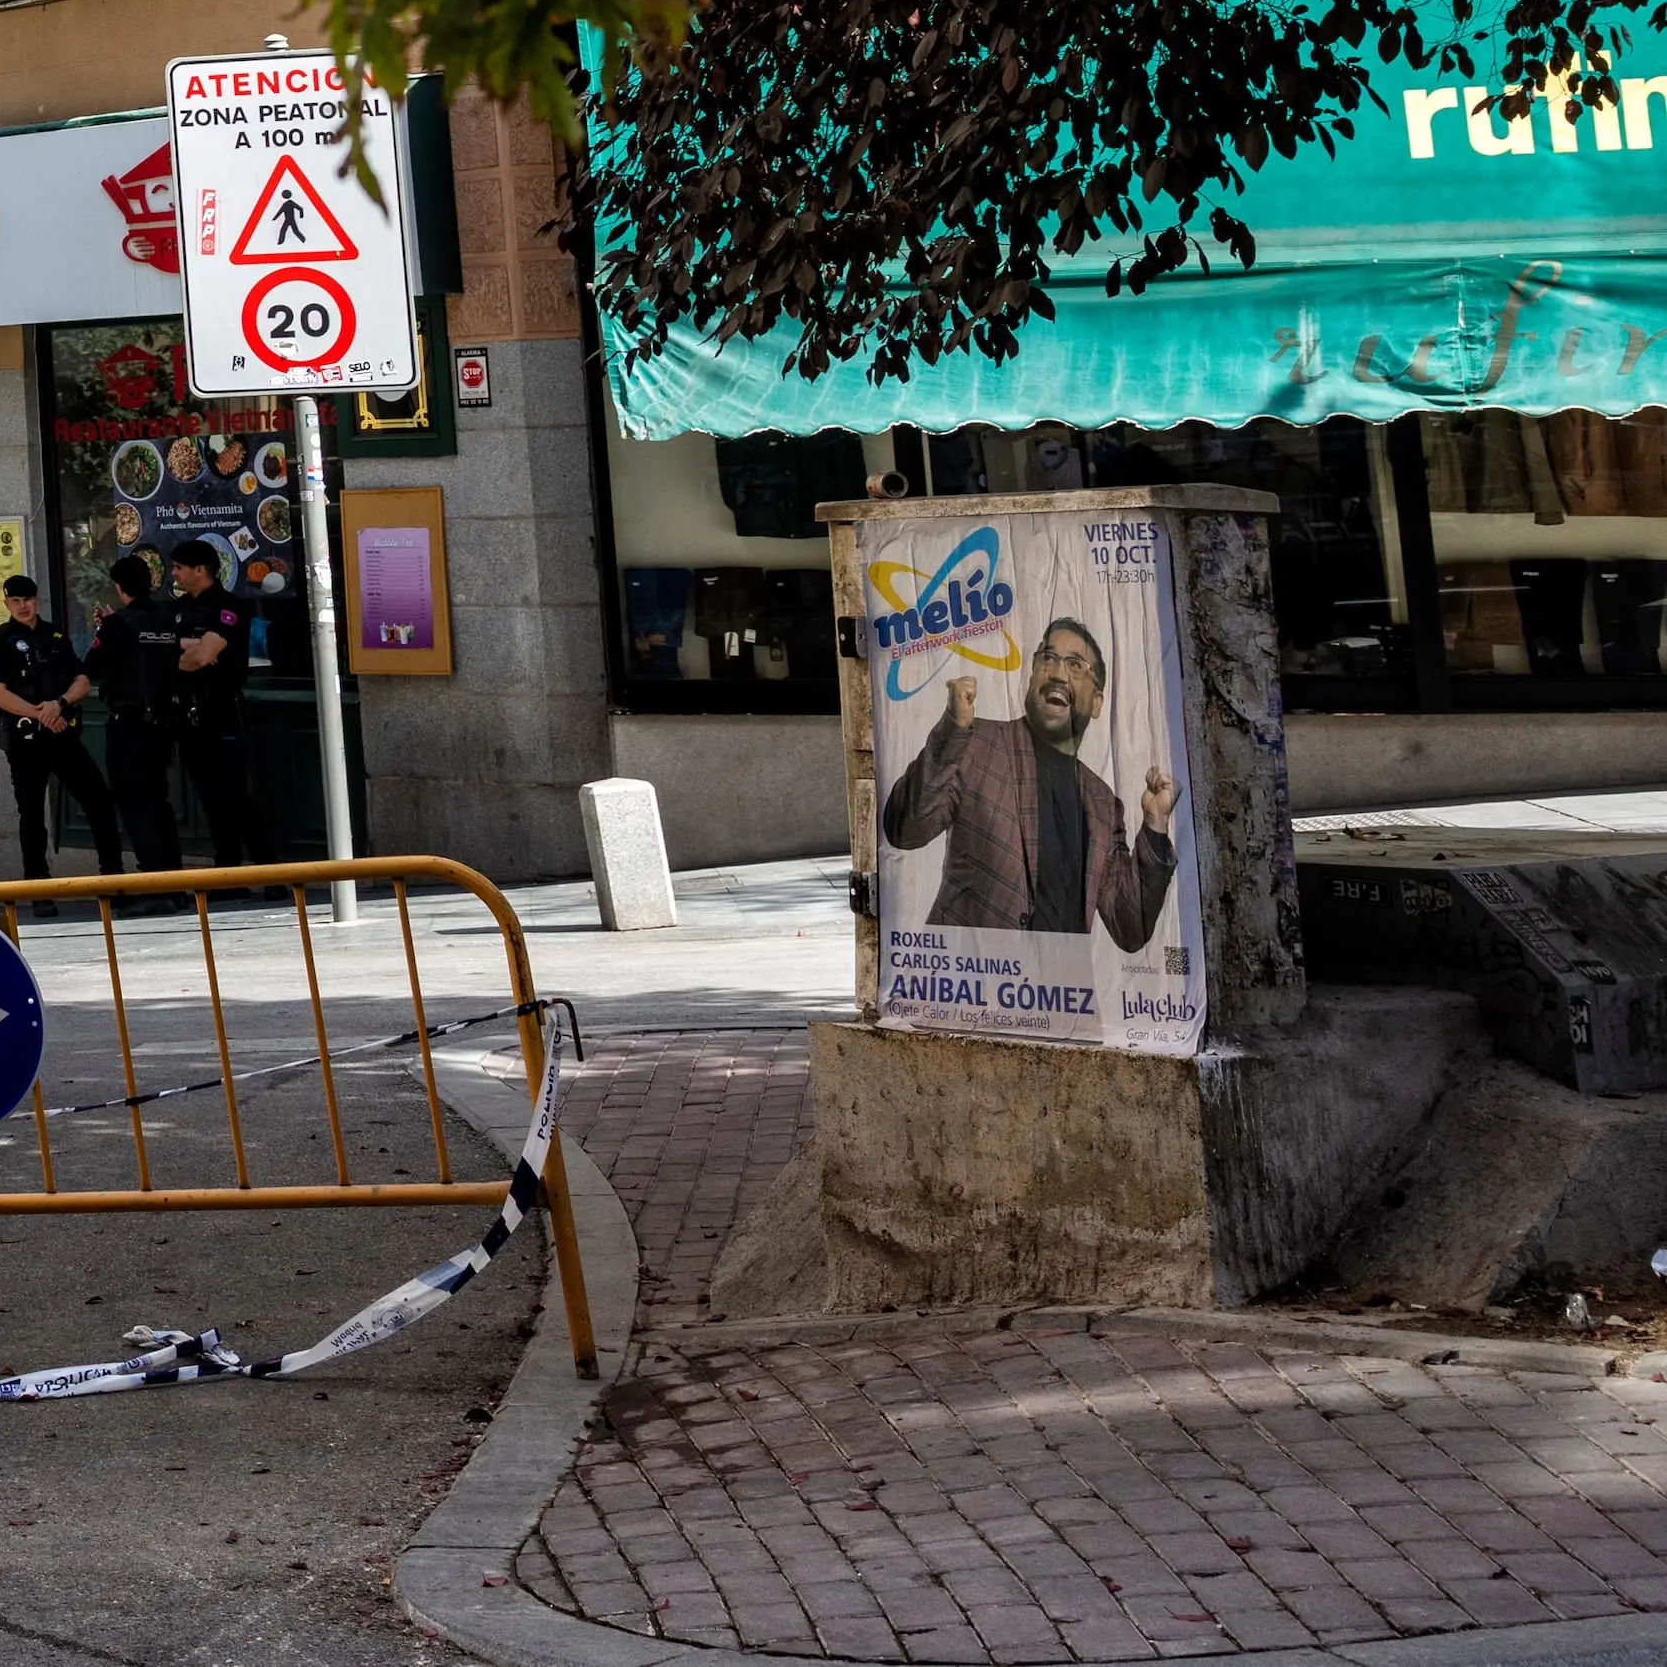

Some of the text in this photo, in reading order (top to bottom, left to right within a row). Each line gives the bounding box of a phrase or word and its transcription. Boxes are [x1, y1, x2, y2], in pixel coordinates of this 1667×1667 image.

[180, 106, 248, 127] ZONA
[235, 132, 252, 149] A
[262, 129, 304, 147] 100
[267, 303, 331, 339] 20
[349, 361, 370, 373] SELO
[463, 368, 482, 380] STOP
[54, 411, 201, 443] Restaurante
[190, 503, 244, 517] Vietnamita
[160, 519, 241, 530] Authentic flavours of Vietnam
[1083, 522, 1159, 543] VIERNES
[1091, 545, 1157, 565] 10 OCT.
[1096, 569, 1155, 584] 17h-23:30h
[873, 568, 1014, 649] melío
[891, 645, 902, 660] El
[904, 629, 960, 655] afterwork
[1463, 872, 1508, 888] PABLO
[890, 931, 947, 950] ROXELL
[890, 952, 1021, 976] CARLOS SALINAS
[888, 971, 1094, 1014] ANÍBAL GÓMEZ
[889, 1002, 920, 1020] (Ojete
[922, 1005, 950, 1021] Calor
[960, 1009, 979, 1024] Los
[980, 1010, 1013, 1027] felices
[1015, 1013, 1050, 1030] veinte)
[1126, 1028, 1149, 1041] Gran
